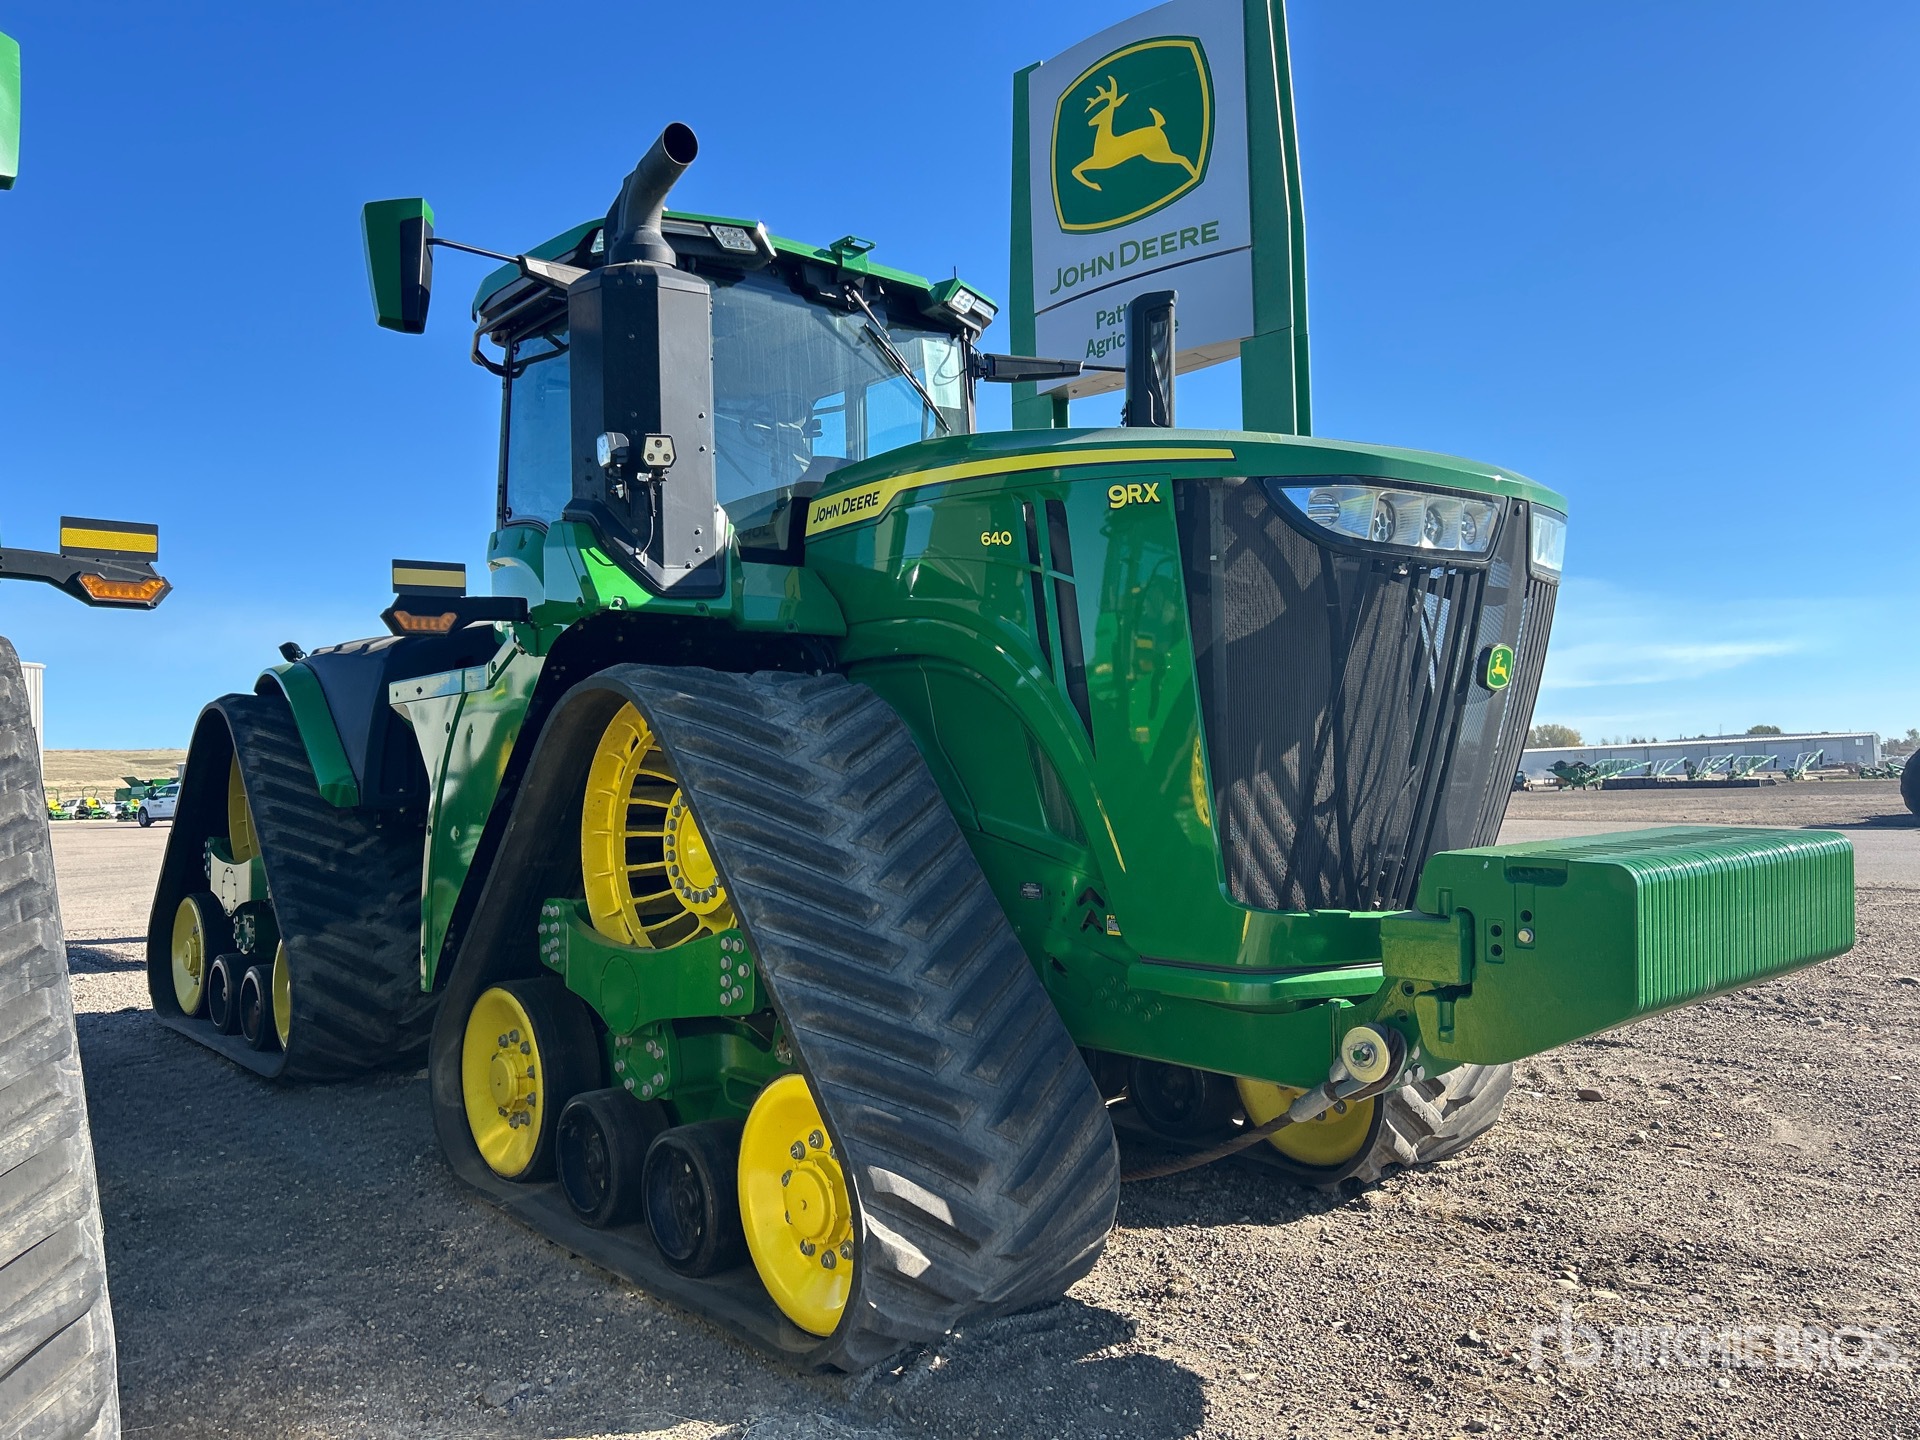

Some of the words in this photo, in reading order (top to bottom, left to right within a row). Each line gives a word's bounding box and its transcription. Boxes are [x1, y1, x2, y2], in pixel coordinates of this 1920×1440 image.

[1050, 251, 1114, 294] JOHN
[1119, 220, 1220, 268] DEERE
[813, 503, 841, 524] JOHN
[841, 491, 880, 515] DEERE
[1108, 482, 1160, 509] 9RX
[980, 530, 1013, 546] 640
